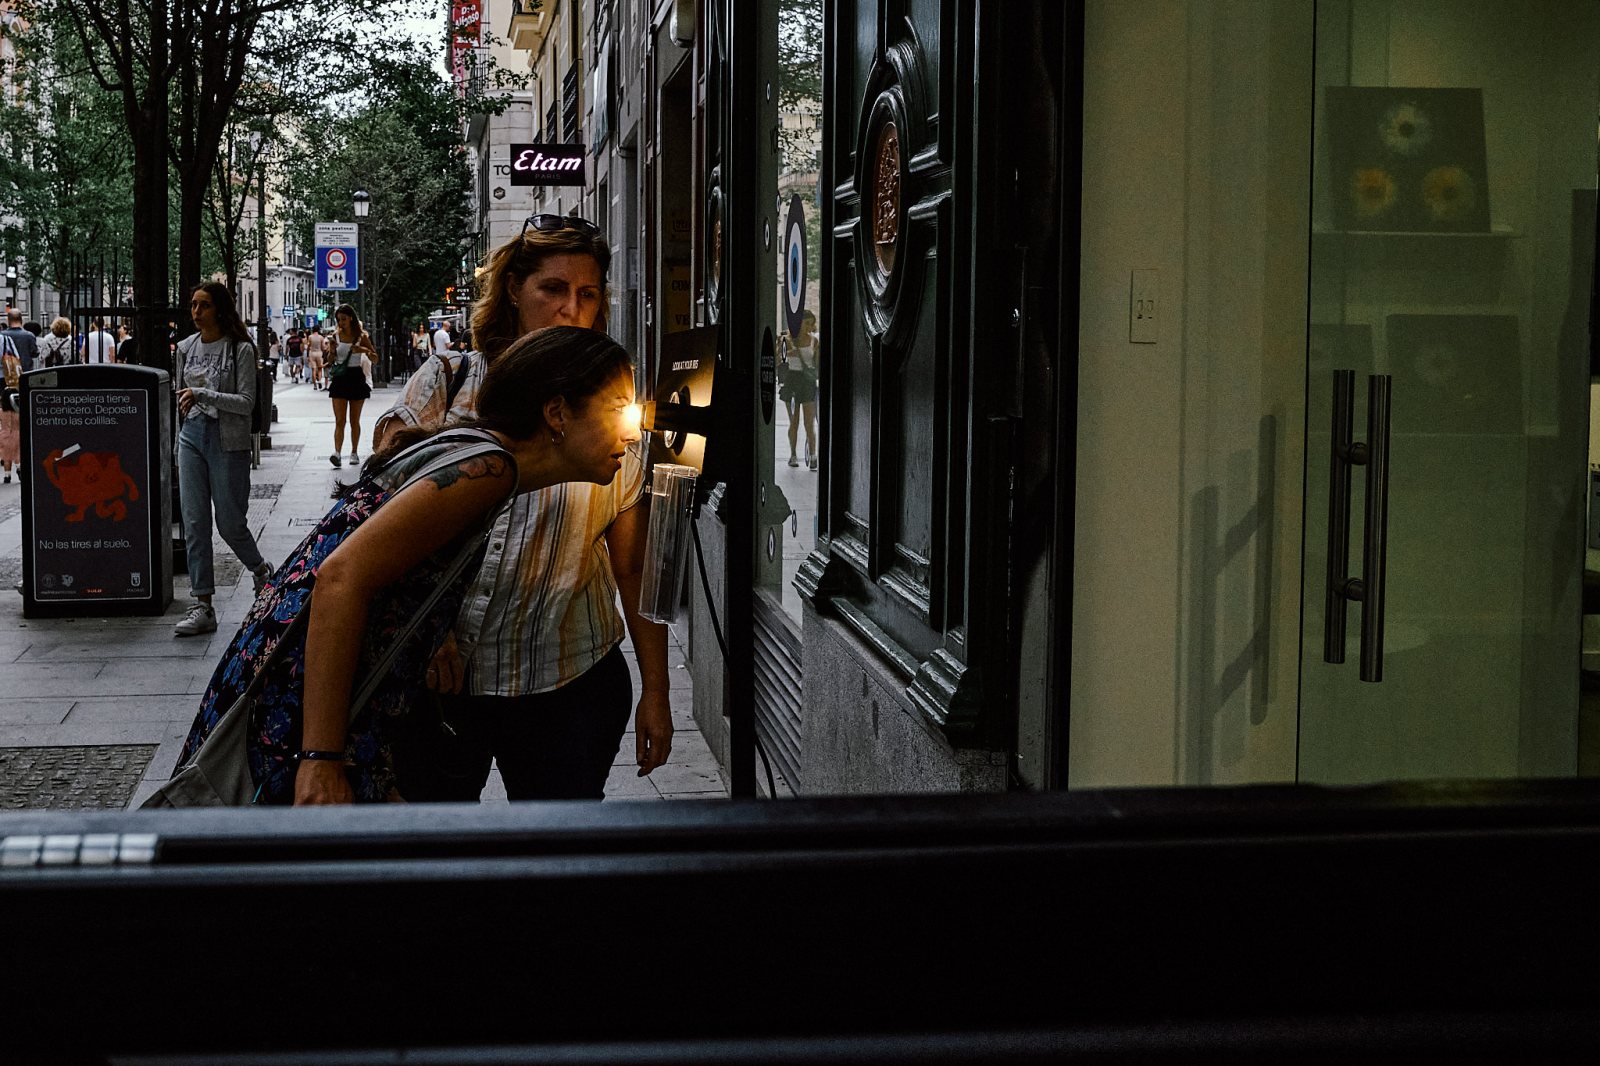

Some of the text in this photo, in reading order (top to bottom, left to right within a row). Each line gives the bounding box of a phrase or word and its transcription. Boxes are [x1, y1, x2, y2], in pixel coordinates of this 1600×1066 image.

[513, 149, 582, 171] Etam
[63, 394, 104, 406] papelera
[107, 394, 130, 404] tiene
[36, 404, 137, 416] su cenicero. Deposita
[36, 415, 119, 426] dentro las colillas.
[40, 538, 132, 549] No las tires al suelo.
